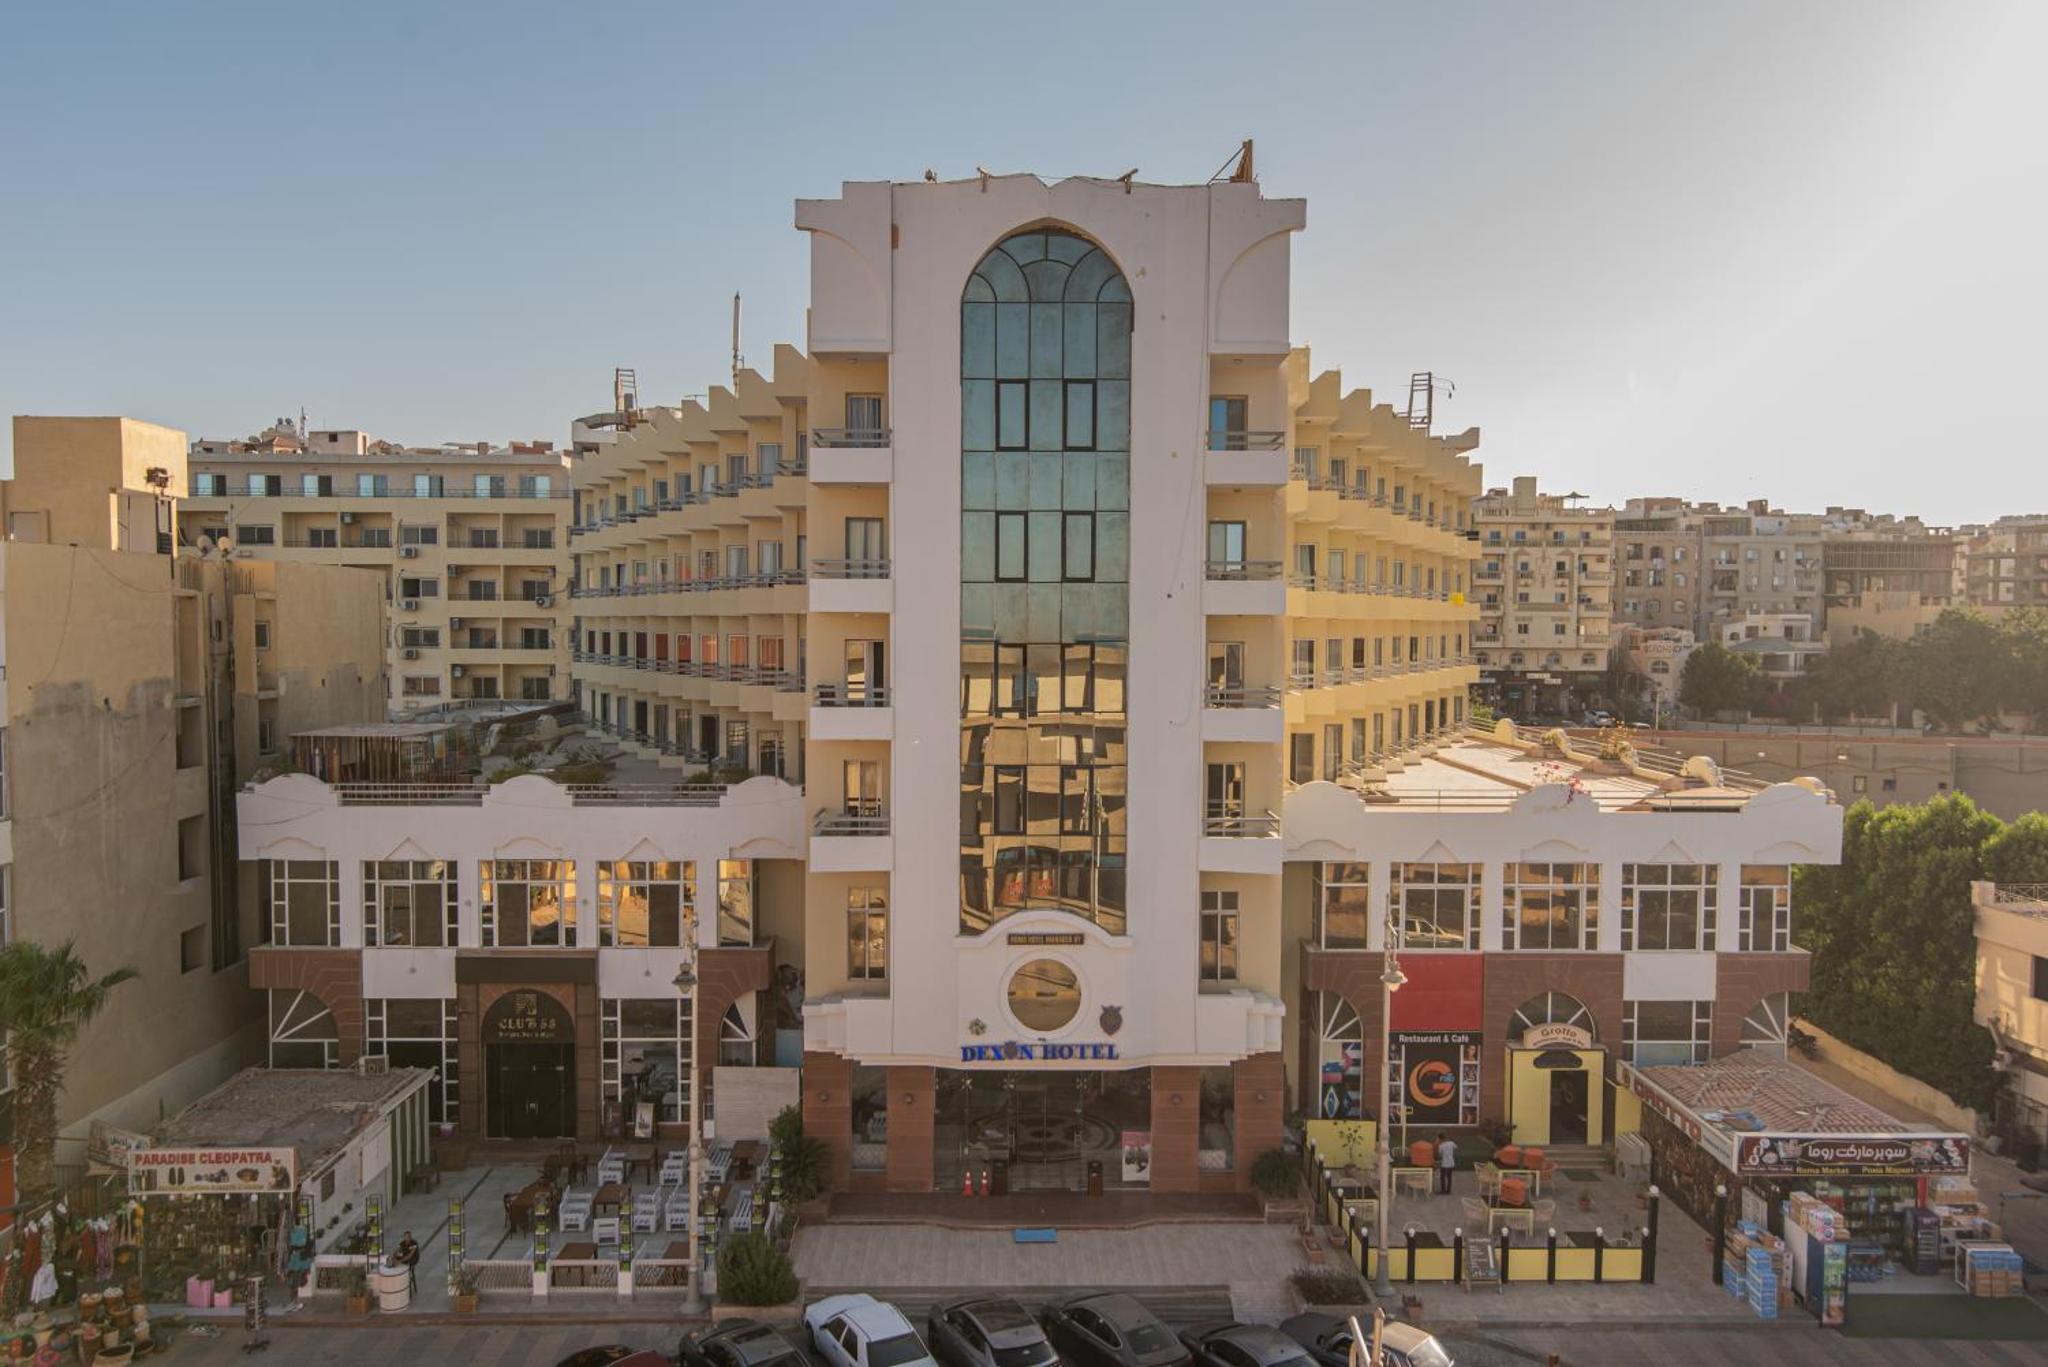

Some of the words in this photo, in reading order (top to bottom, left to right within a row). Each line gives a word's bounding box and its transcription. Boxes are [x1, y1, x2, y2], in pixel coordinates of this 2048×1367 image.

[499, 1018, 538, 1030] CLUB
[1399, 1034, 1442, 1043] Restaurant
[1443, 1034, 1450, 1043] &
[1541, 1027, 1577, 1038] Grotto
[1042, 1043, 1119, 1060] HOTEL
[135, 1153, 195, 1166] PARADISE
[199, 1152, 273, 1165] CLEOPATRA
[1808, 1145, 1835, 1160] روما
